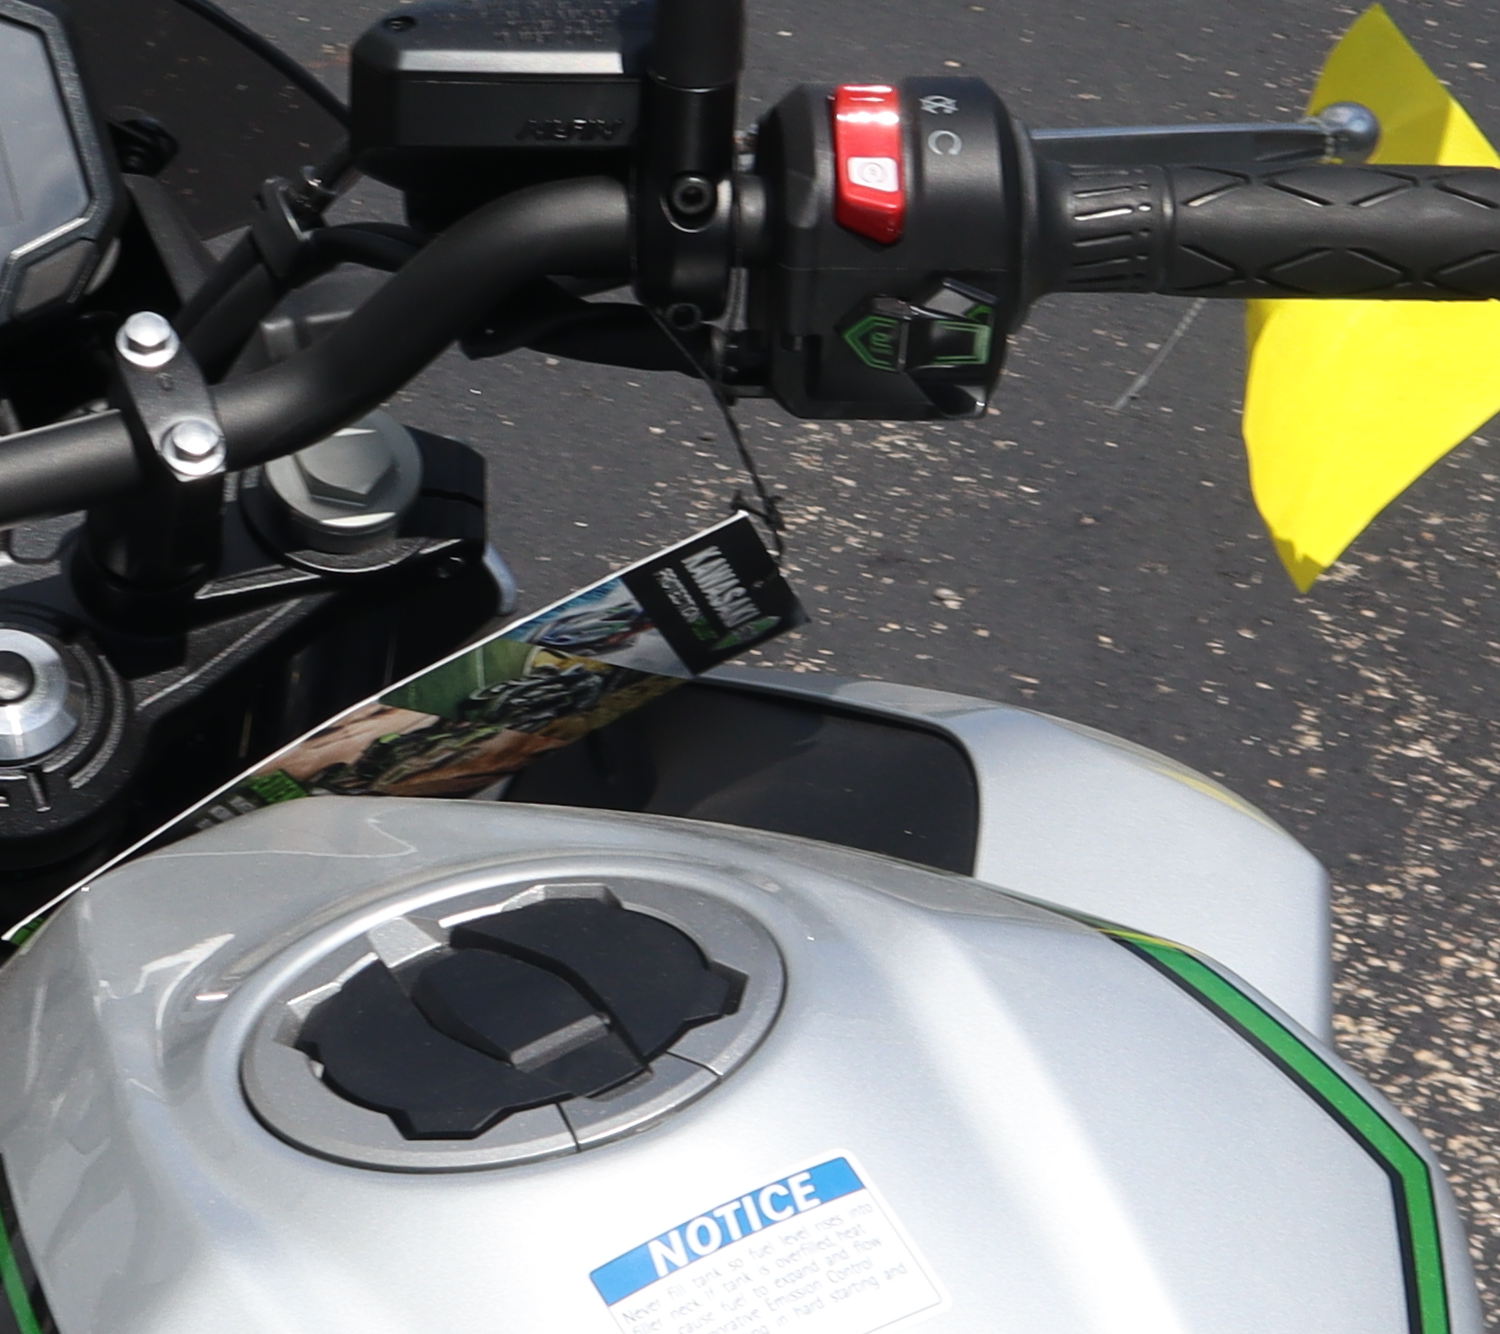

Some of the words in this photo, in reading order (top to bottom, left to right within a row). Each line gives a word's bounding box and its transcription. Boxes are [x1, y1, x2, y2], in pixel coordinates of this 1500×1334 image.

[680, 545, 761, 628] KAWASAKI
[622, 1298, 662, 1325] Never
[667, 1284, 686, 1300] fill
[692, 1267, 723, 1289] tank
[729, 1257, 744, 1272] so
[748, 1243, 775, 1261] fuel
[780, 1225, 811, 1248] level
[815, 1215, 844, 1233] rises
[849, 1202, 874, 1220] into
[648, 1172, 820, 1278] NOTICE
[722, 1272, 753, 1292] tank
[759, 1263, 771, 1276] is
[836, 1223, 867, 1245] heat
[720, 1295, 748, 1313] fuel
[753, 1284, 769, 1298] to
[774, 1261, 820, 1289] expand
[826, 1249, 850, 1266] and
[854, 1236, 883, 1254] flow
[765, 1279, 823, 1313] Emission
[827, 1257, 874, 1284] Control
[776, 1313, 789, 1328] in
[794, 1295, 826, 1318] hard
[830, 1274, 880, 1303] starting
[884, 1263, 909, 1282] and
